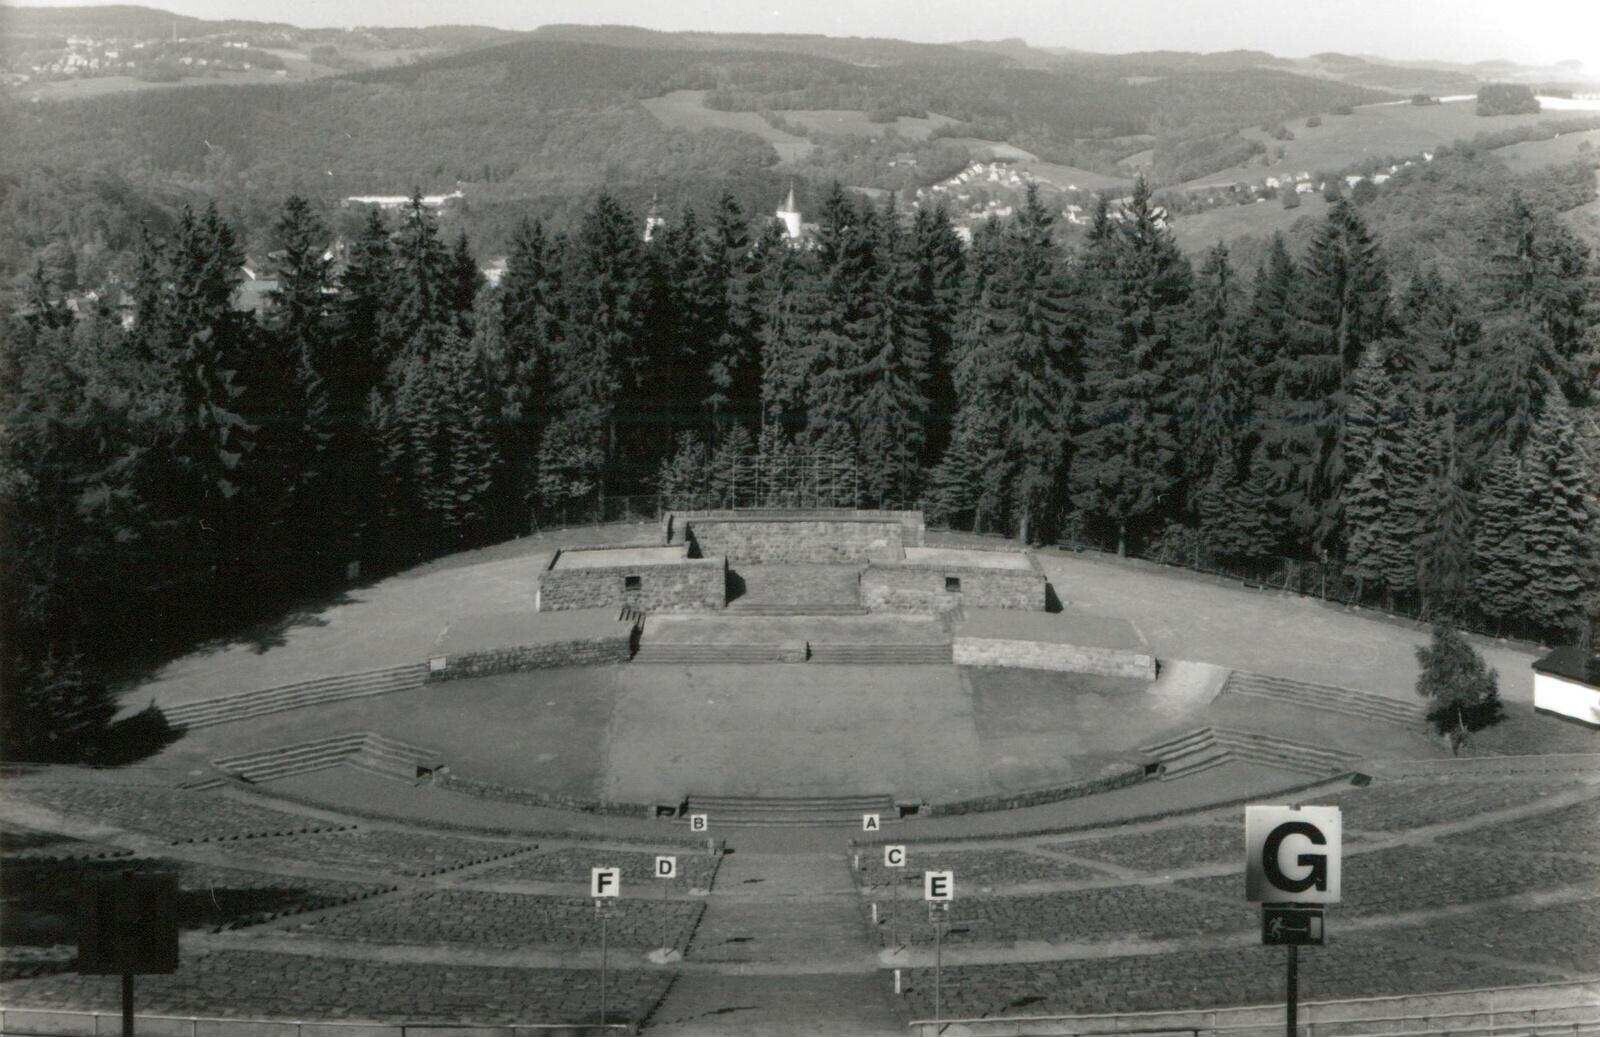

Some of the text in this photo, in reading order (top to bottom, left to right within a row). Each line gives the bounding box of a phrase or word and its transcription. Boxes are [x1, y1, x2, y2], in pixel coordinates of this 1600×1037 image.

[694, 817, 704, 829] B
[866, 817, 877, 829] A
[888, 849, 901, 864] C
[1263, 822, 1327, 893] G
[660, 860, 672, 875] D
[598, 873, 613, 893] F
[931, 877, 947, 897] E
